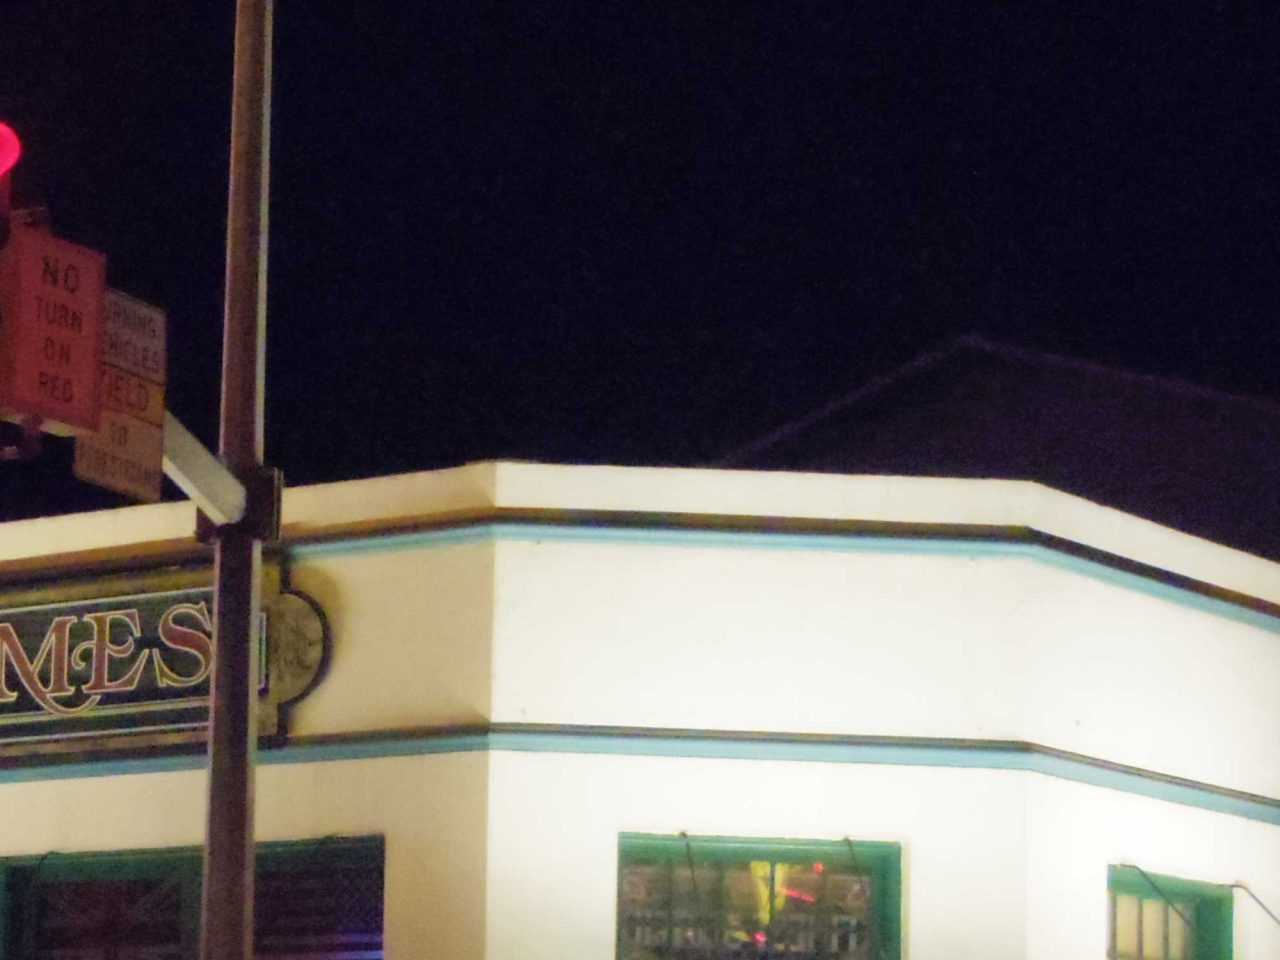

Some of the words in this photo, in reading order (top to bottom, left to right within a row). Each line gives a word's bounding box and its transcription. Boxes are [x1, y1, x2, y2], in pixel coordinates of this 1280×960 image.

[43, 256, 80, 294] NO
[35, 296, 83, 334] TURN
[43, 336, 71, 366] ON
[39, 371, 74, 404] RED
